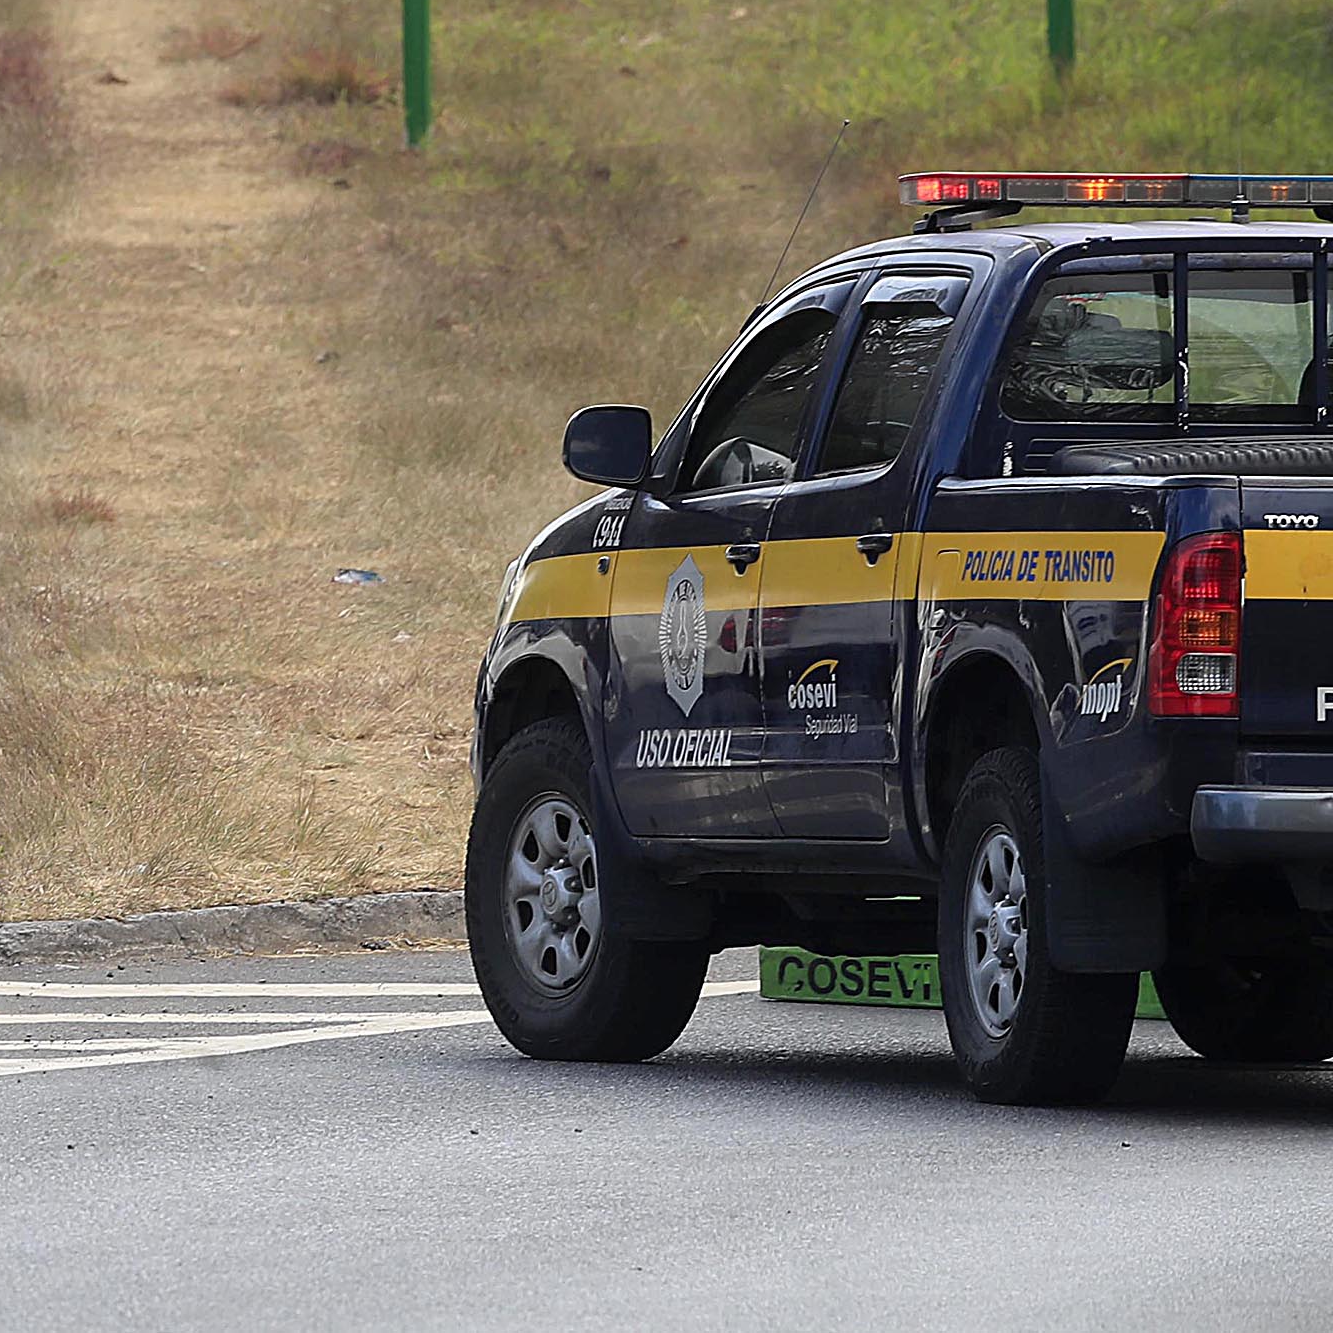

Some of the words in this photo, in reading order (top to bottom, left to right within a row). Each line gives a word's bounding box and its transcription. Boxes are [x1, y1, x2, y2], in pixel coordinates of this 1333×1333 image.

[961, 550, 1016, 582] POLICIA
[1016, 550, 1040, 582] DE
[1044, 550, 1115, 583] TRANSITO
[787, 673, 837, 709] cosevi
[1080, 673, 1122, 723] mopt
[805, 713, 843, 740] Seguridad
[843, 713, 859, 734] Vial
[636, 728, 671, 768] USO
[673, 728, 733, 768] OFICIAL
[778, 955, 932, 1001] COSEVI
